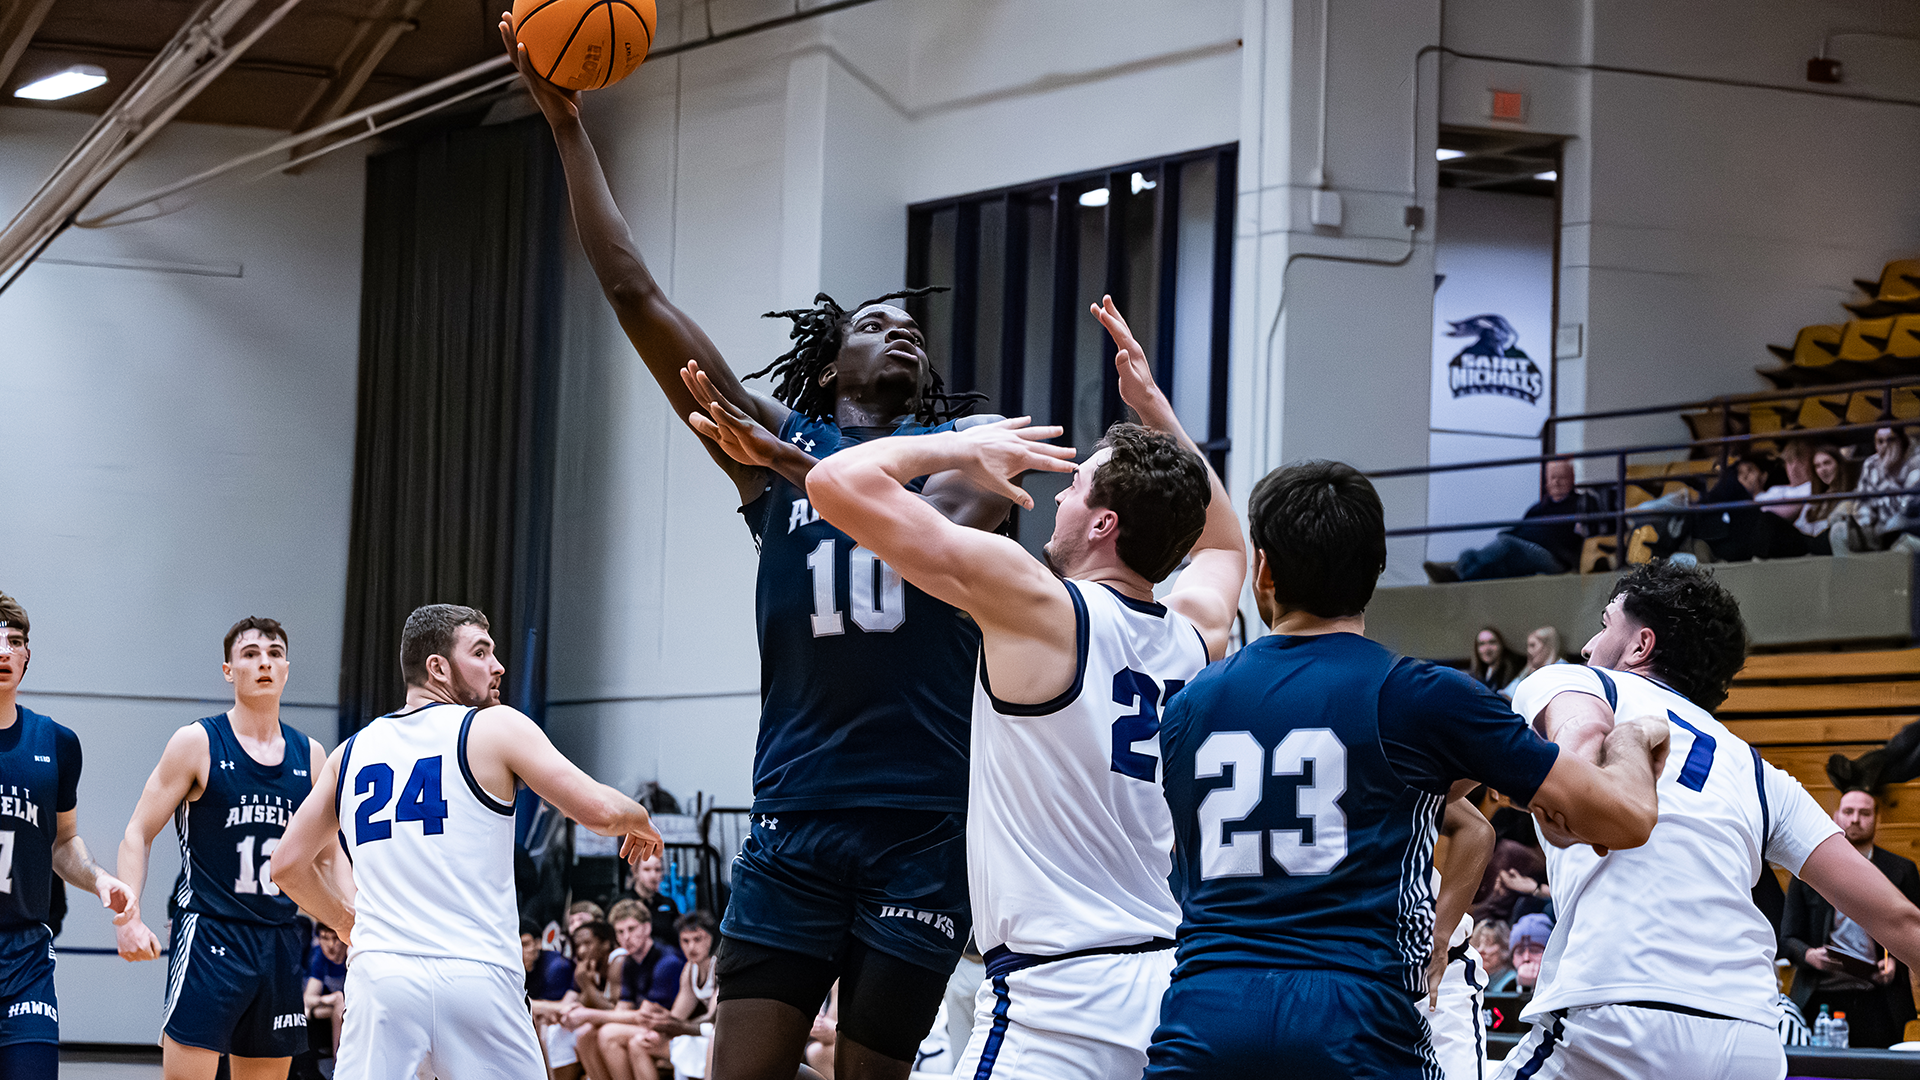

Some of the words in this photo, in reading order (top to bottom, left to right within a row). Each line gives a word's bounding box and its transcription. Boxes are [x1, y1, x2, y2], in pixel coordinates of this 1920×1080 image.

[807, 538, 906, 638] 10
[224, 805, 294, 828] ANSEL
[240, 794, 293, 809] SAINT
[354, 754, 448, 847] 24
[1195, 727, 1349, 882] 23
[8, 1000, 58, 1023] HAWKS
